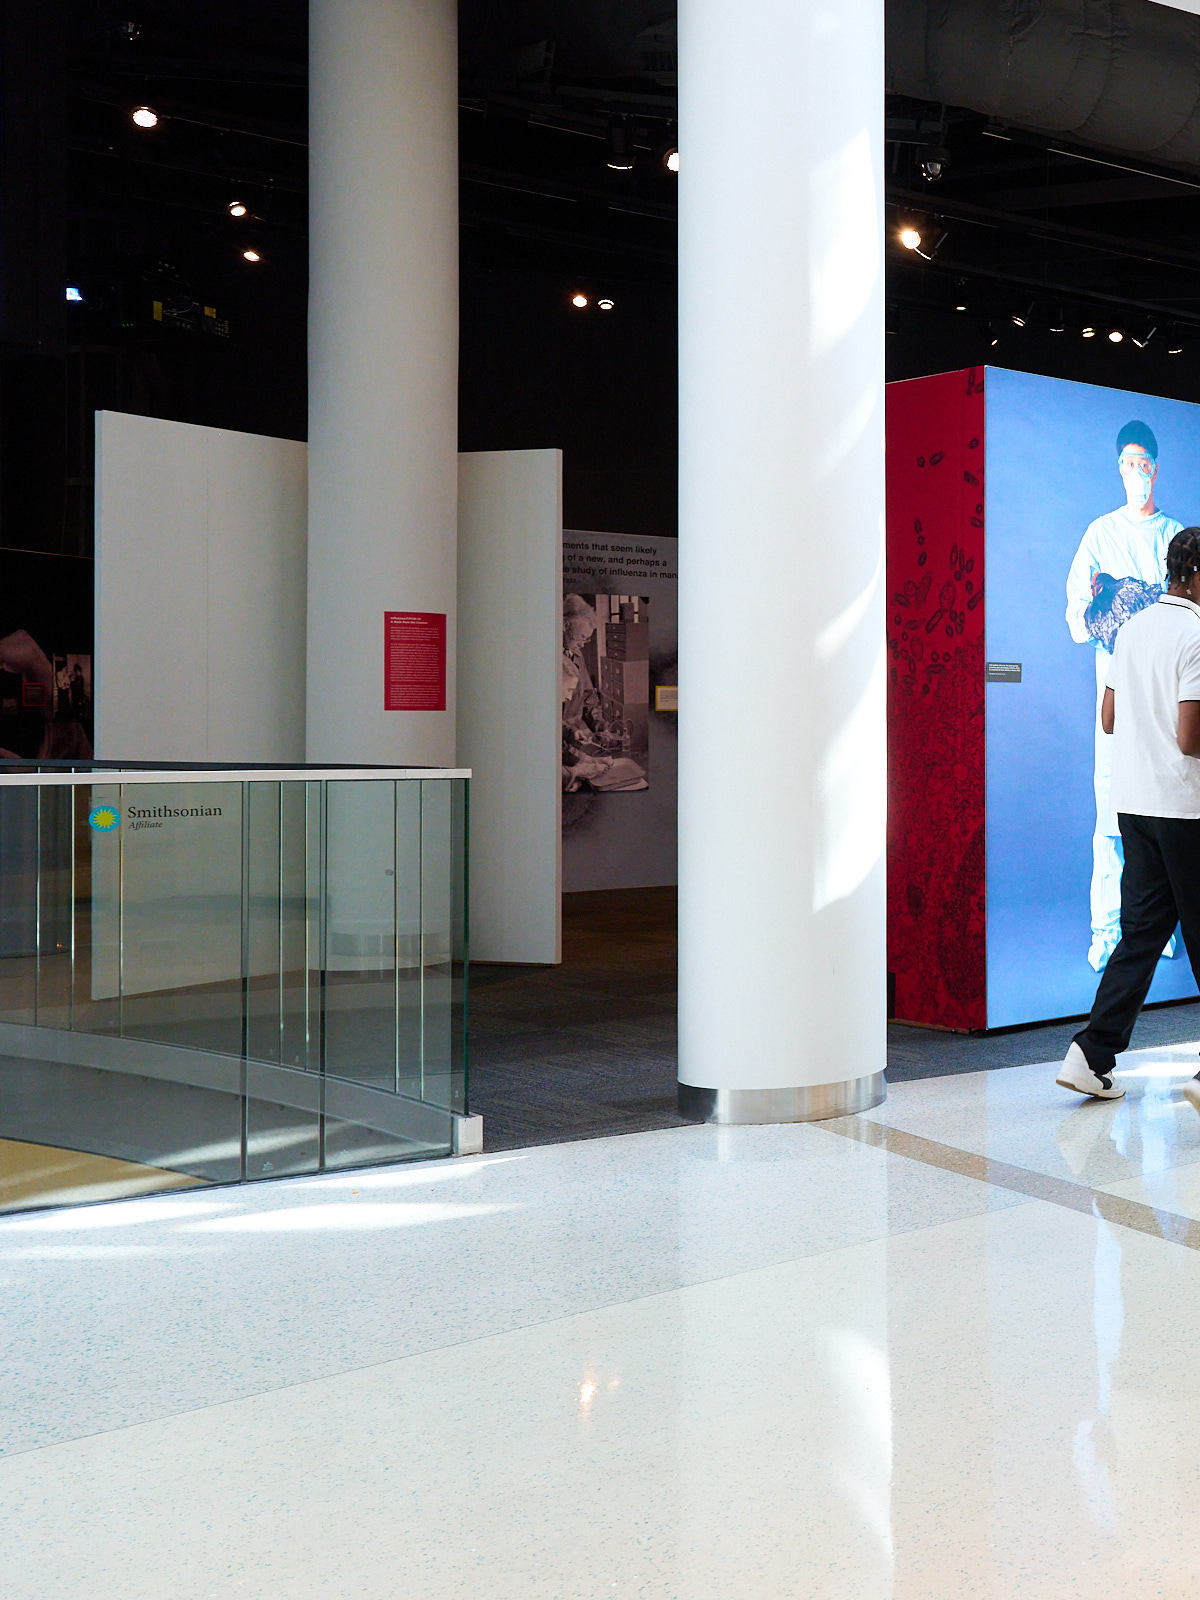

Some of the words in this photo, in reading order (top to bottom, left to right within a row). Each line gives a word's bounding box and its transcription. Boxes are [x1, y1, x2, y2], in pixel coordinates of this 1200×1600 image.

[592, 543, 608, 551] that
[611, 545, 633, 553] seem
[635, 546, 657, 556] likely
[568, 554, 577, 562] of
[608, 555, 624, 564] and
[626, 558, 660, 567] perhaps
[572, 566, 596, 576] study
[609, 568, 647, 577] influenza
[650, 570, 658, 578] in
[128, 805, 222, 818] Smithsonian
[129, 821, 163, 830] Affiliate
